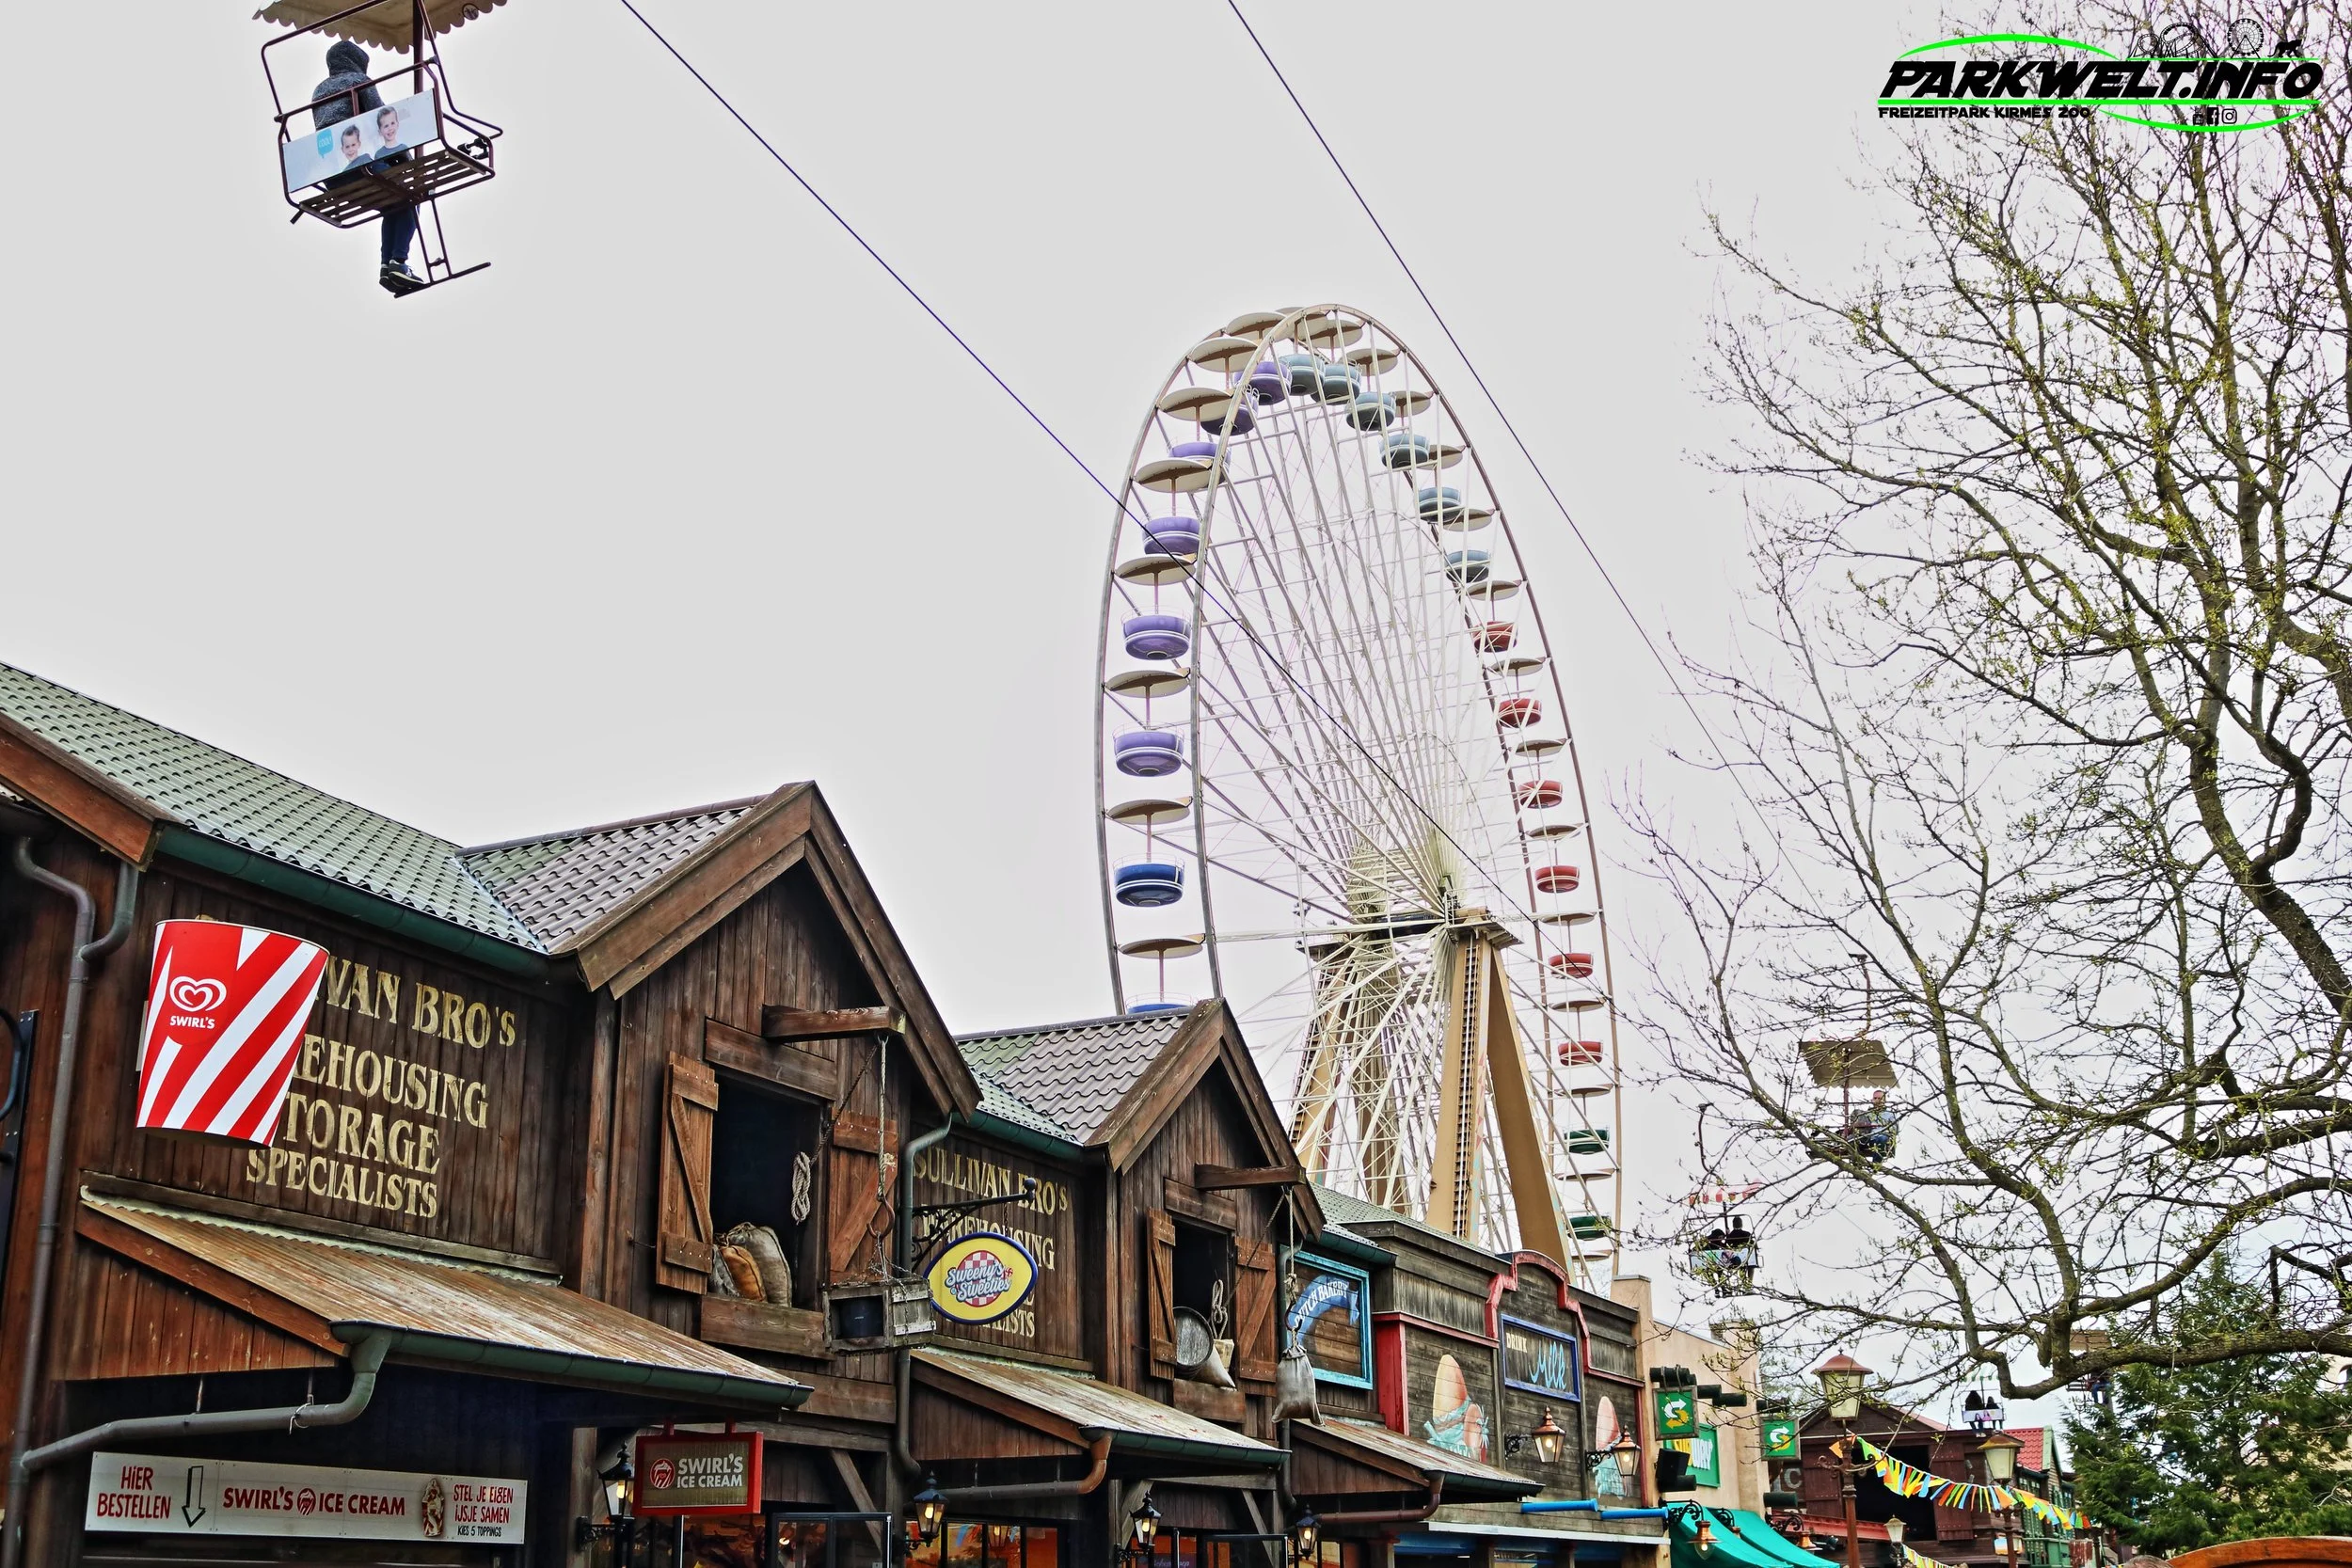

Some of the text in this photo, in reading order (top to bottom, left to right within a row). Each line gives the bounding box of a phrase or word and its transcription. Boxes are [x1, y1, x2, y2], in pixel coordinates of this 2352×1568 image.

[315, 955, 516, 1049] VAN BRO'S
[169, 1016, 215, 1029] SWIRL'S
[293, 1033, 489, 1130] EHOUSING
[283, 1091, 440, 1175] TORAGE
[246, 1147, 437, 1218] SPECIALISTS
[946, 1260, 1004, 1287] Sweeny's
[957, 1276, 1011, 1302] Sweeties
[1505, 1332, 1528, 1354] DRINK
[1528, 1339, 1566, 1390] Milk
[677, 1453, 743, 1475] SWIRL'S
[453, 1483, 473, 1502] STEL
[476, 1485, 487, 1503] JE
[676, 1474, 743, 1488] ICE CREAM
[96, 1493, 171, 1519] BESTELLEN
[222, 1485, 405, 1516] SWIRL'S ICE CREAM
[480, 1505, 510, 1524] SAMEN
[470, 1525, 476, 1537] 5
